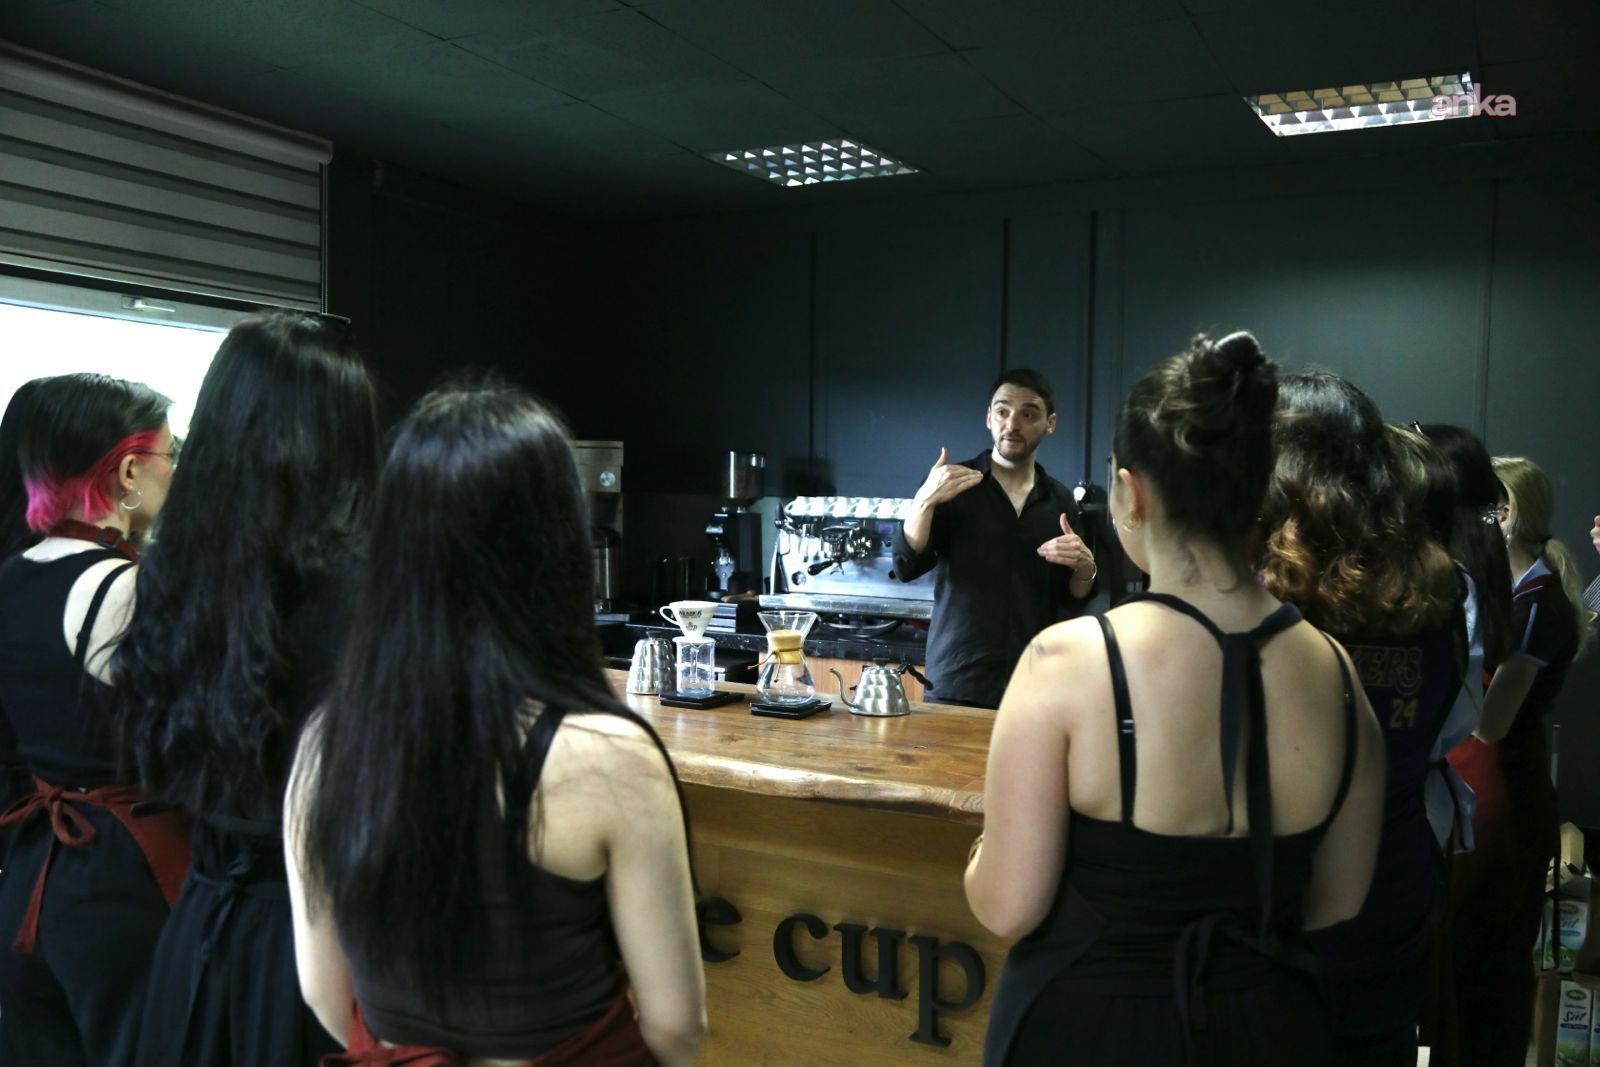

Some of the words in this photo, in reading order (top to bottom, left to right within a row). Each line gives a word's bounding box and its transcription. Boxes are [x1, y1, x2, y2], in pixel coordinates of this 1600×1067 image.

[1388, 697, 1419, 729] 24
[697, 897, 742, 963] e
[773, 912, 987, 1047] cup
